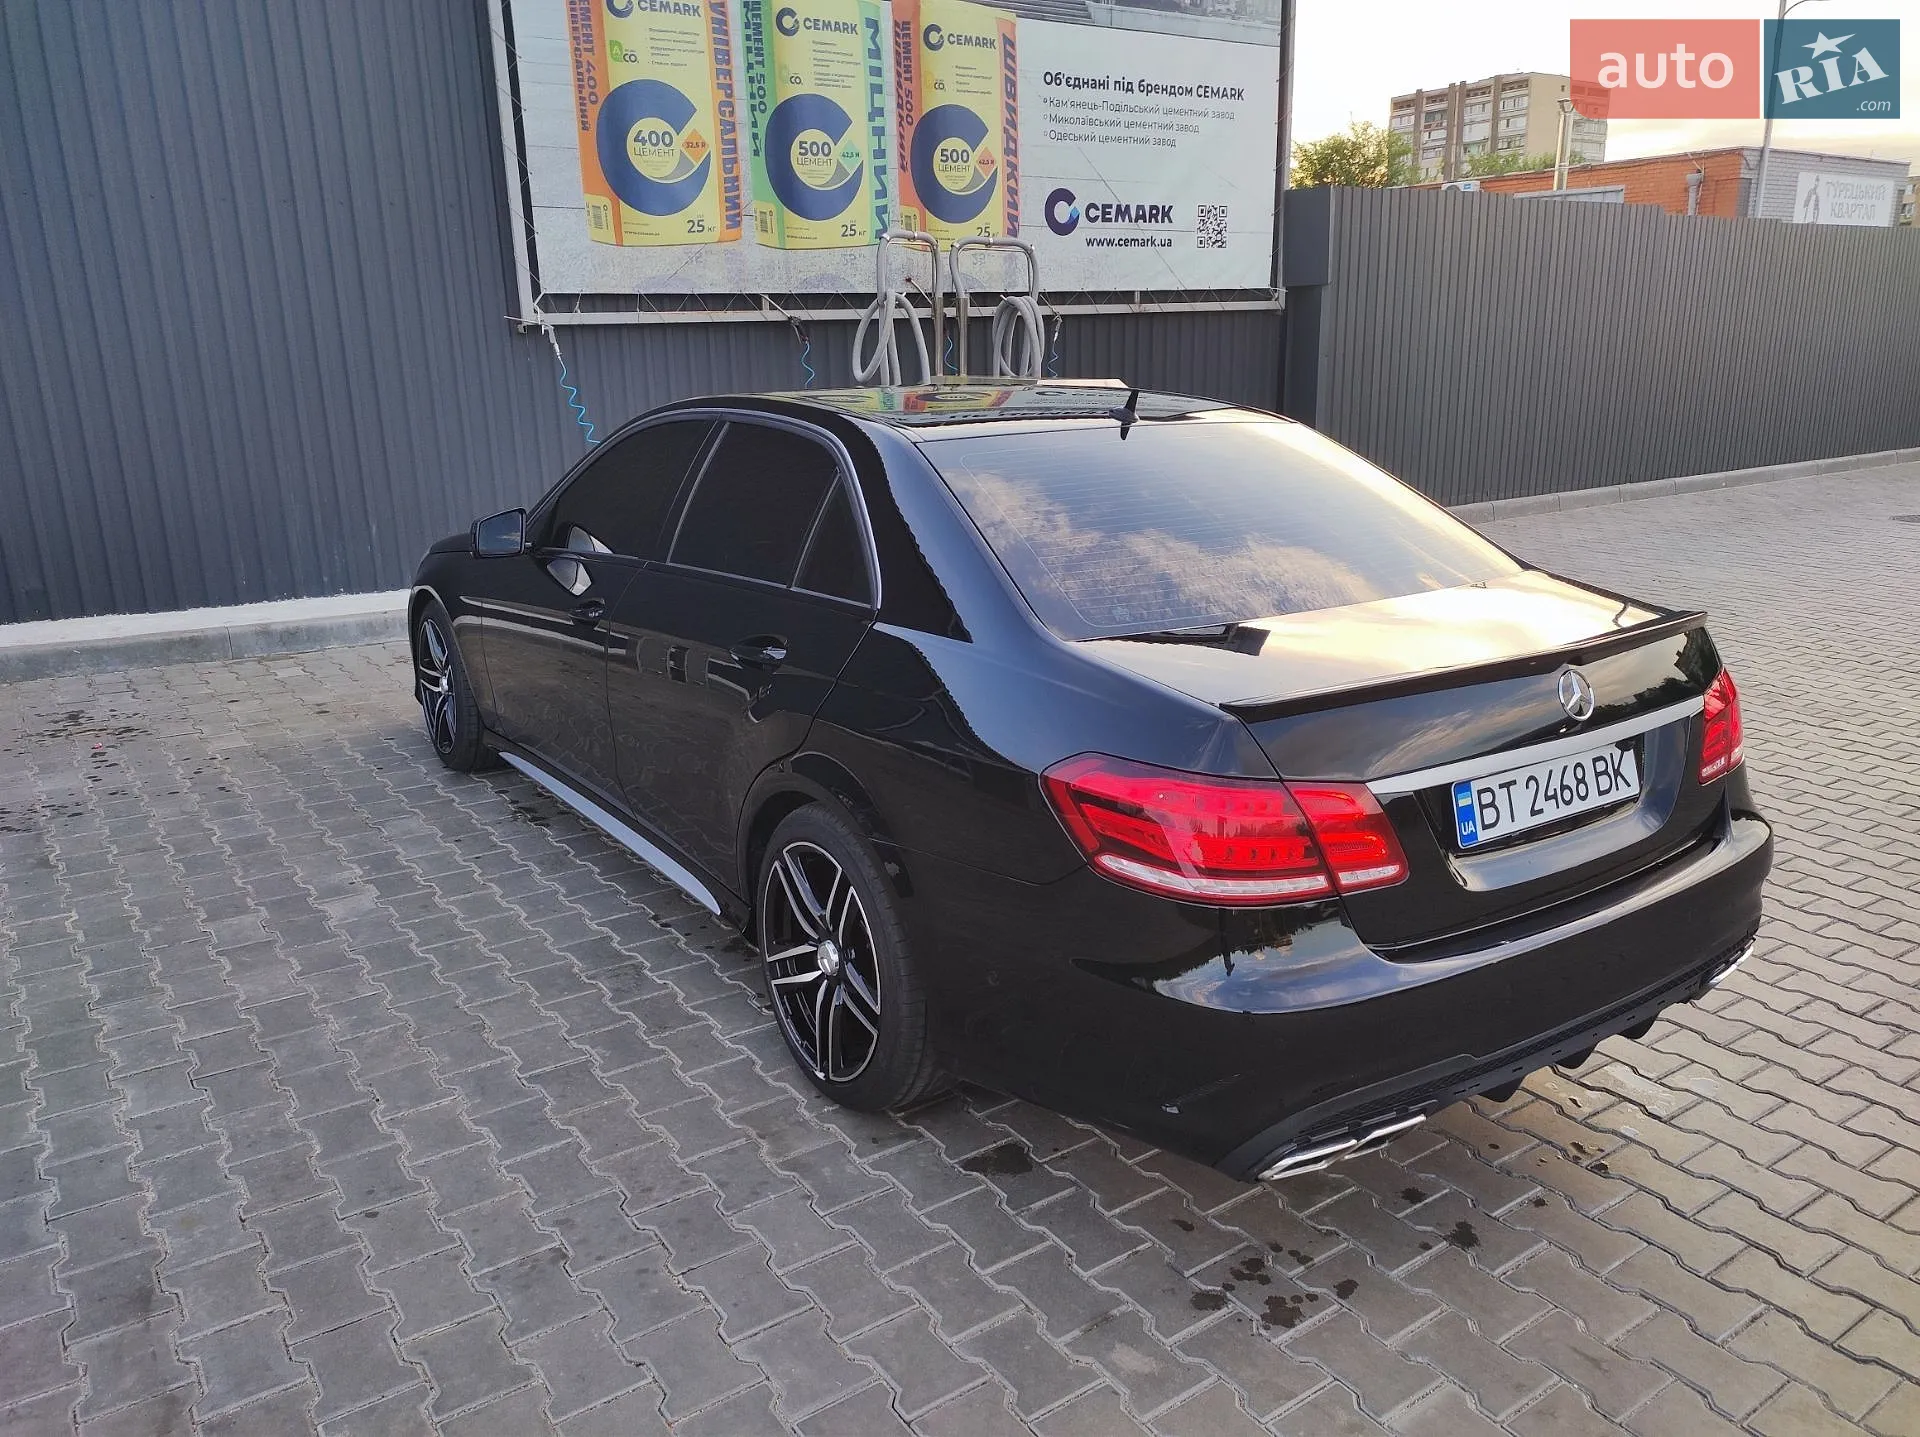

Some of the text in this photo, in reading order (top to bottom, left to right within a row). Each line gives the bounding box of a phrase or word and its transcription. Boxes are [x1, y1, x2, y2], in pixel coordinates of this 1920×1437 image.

[638, 0, 702, 17] CEMARK
[803, 17, 859, 35] CEMARK
[947, 33, 997, 50] CEMARK
[750, 1, 768, 114] ЦЕМЕНТ 500
[586, 60, 599, 105] 400
[743, 1, 762, 157] МІЦНИЙ
[901, 21, 914, 126] ЦЕМЕНТ 500
[1043, 71, 1245, 101] Об'єднані під брендом CEMARK
[894, 20, 908, 173] ШВИДКИЙ
[1049, 97, 1235, 121] Кам'янець-Подільський цементний завод
[865, 17, 890, 240] МІЦНИЙ
[1049, 114, 1200, 134] Миколаївський цементний завод
[633, 129, 674, 148] 400
[1049, 129, 1177, 148] Одеський цементний завод
[633, 147, 675, 157] ЦЕМЕНТ
[798, 140, 832, 157] 500
[940, 148, 970, 163] 500
[796, 157, 833, 168] ЦЕМЕНТ
[939, 164, 970, 174] ЦЕМЕНТ
[1826, 181, 1886, 201] ТУРЕЦЬКИЙ
[1085, 202, 1174, 224] CEMARK
[1830, 201, 1876, 220] КВАРТАЛ
[686, 219, 705, 234] 25
[841, 224, 857, 237] 25
[976, 226, 991, 238] 25
[1085, 236, 1172, 248] www.cemark.ua
[1476, 750, 1632, 831] BT 2468 BK
[1461, 821, 1476, 836] UA
